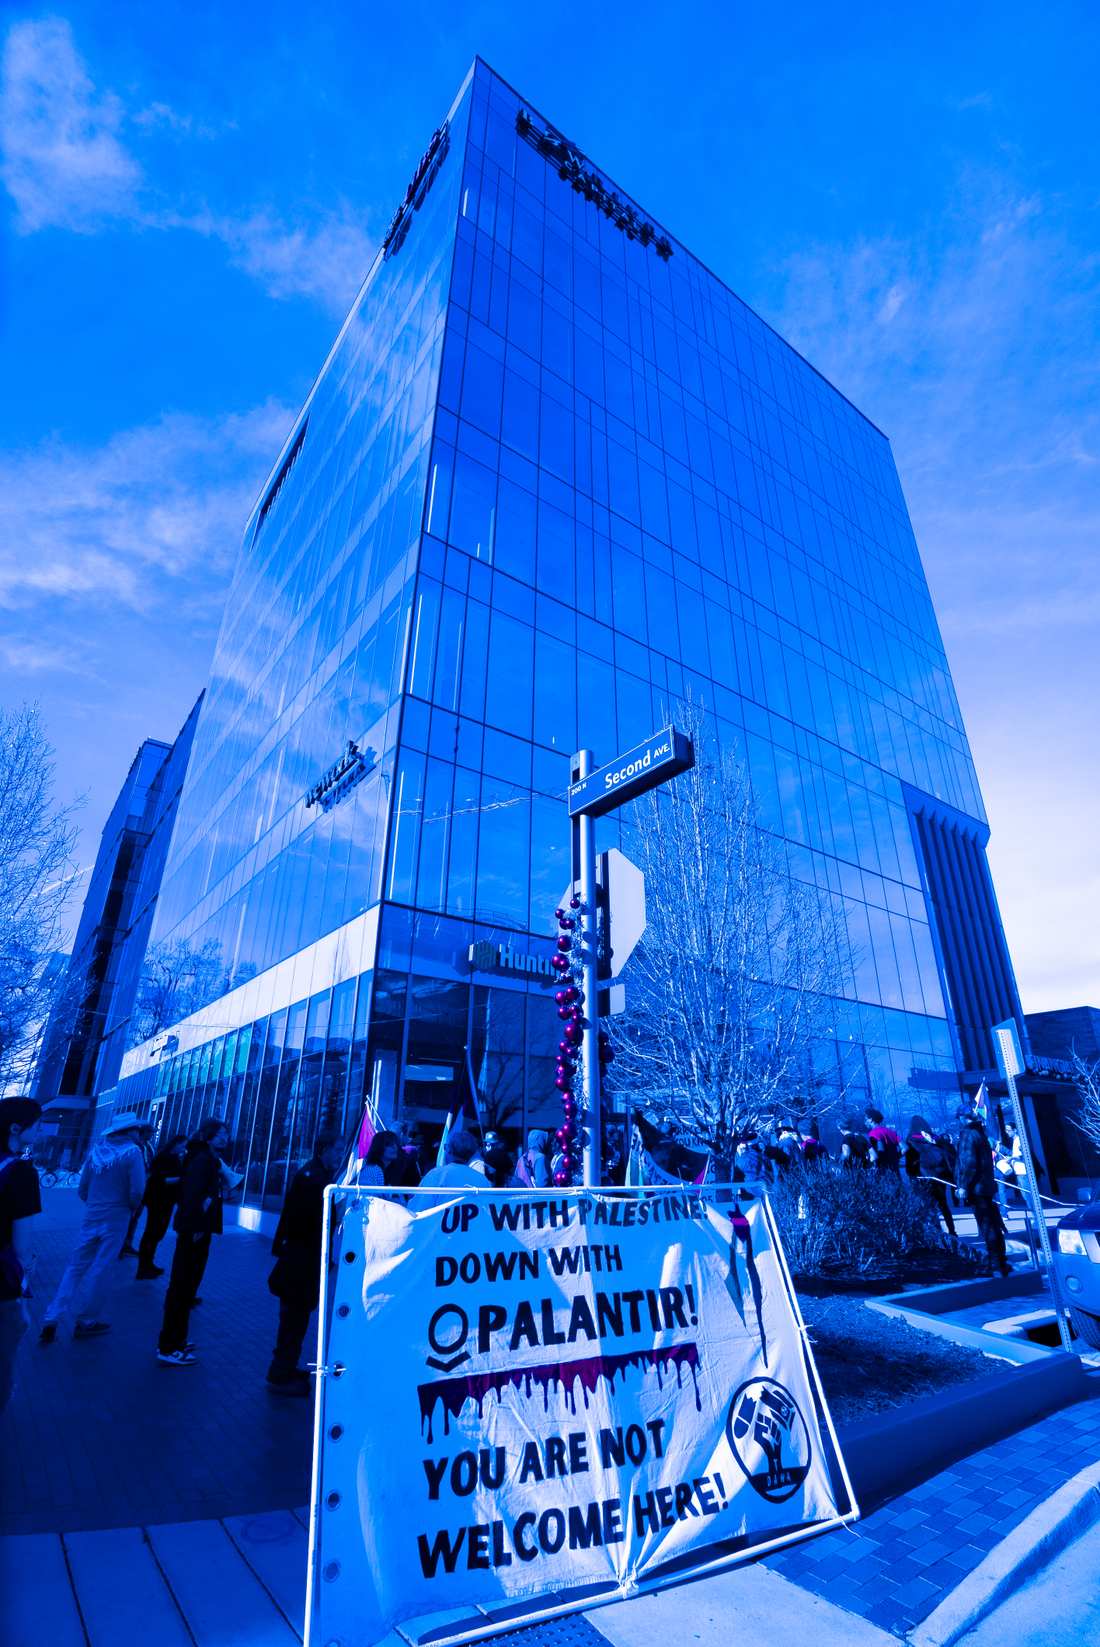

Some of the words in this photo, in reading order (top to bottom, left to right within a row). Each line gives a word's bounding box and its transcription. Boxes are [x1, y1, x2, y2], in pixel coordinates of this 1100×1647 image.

[605, 749, 651, 789] Second
[441, 1204, 479, 1233] UP
[489, 1199, 569, 1231] WITH
[578, 1194, 708, 1228] PALESTINE!
[436, 1250, 538, 1287] DOWN
[549, 1244, 623, 1277] WITH
[477, 1284, 700, 1354] PALANTIR!
[424, 1446, 506, 1500] YOU
[519, 1428, 589, 1485] ARE
[602, 1419, 665, 1471] NOT
[417, 1498, 625, 1580] WELCOME
[634, 1472, 730, 1538] HERE!
